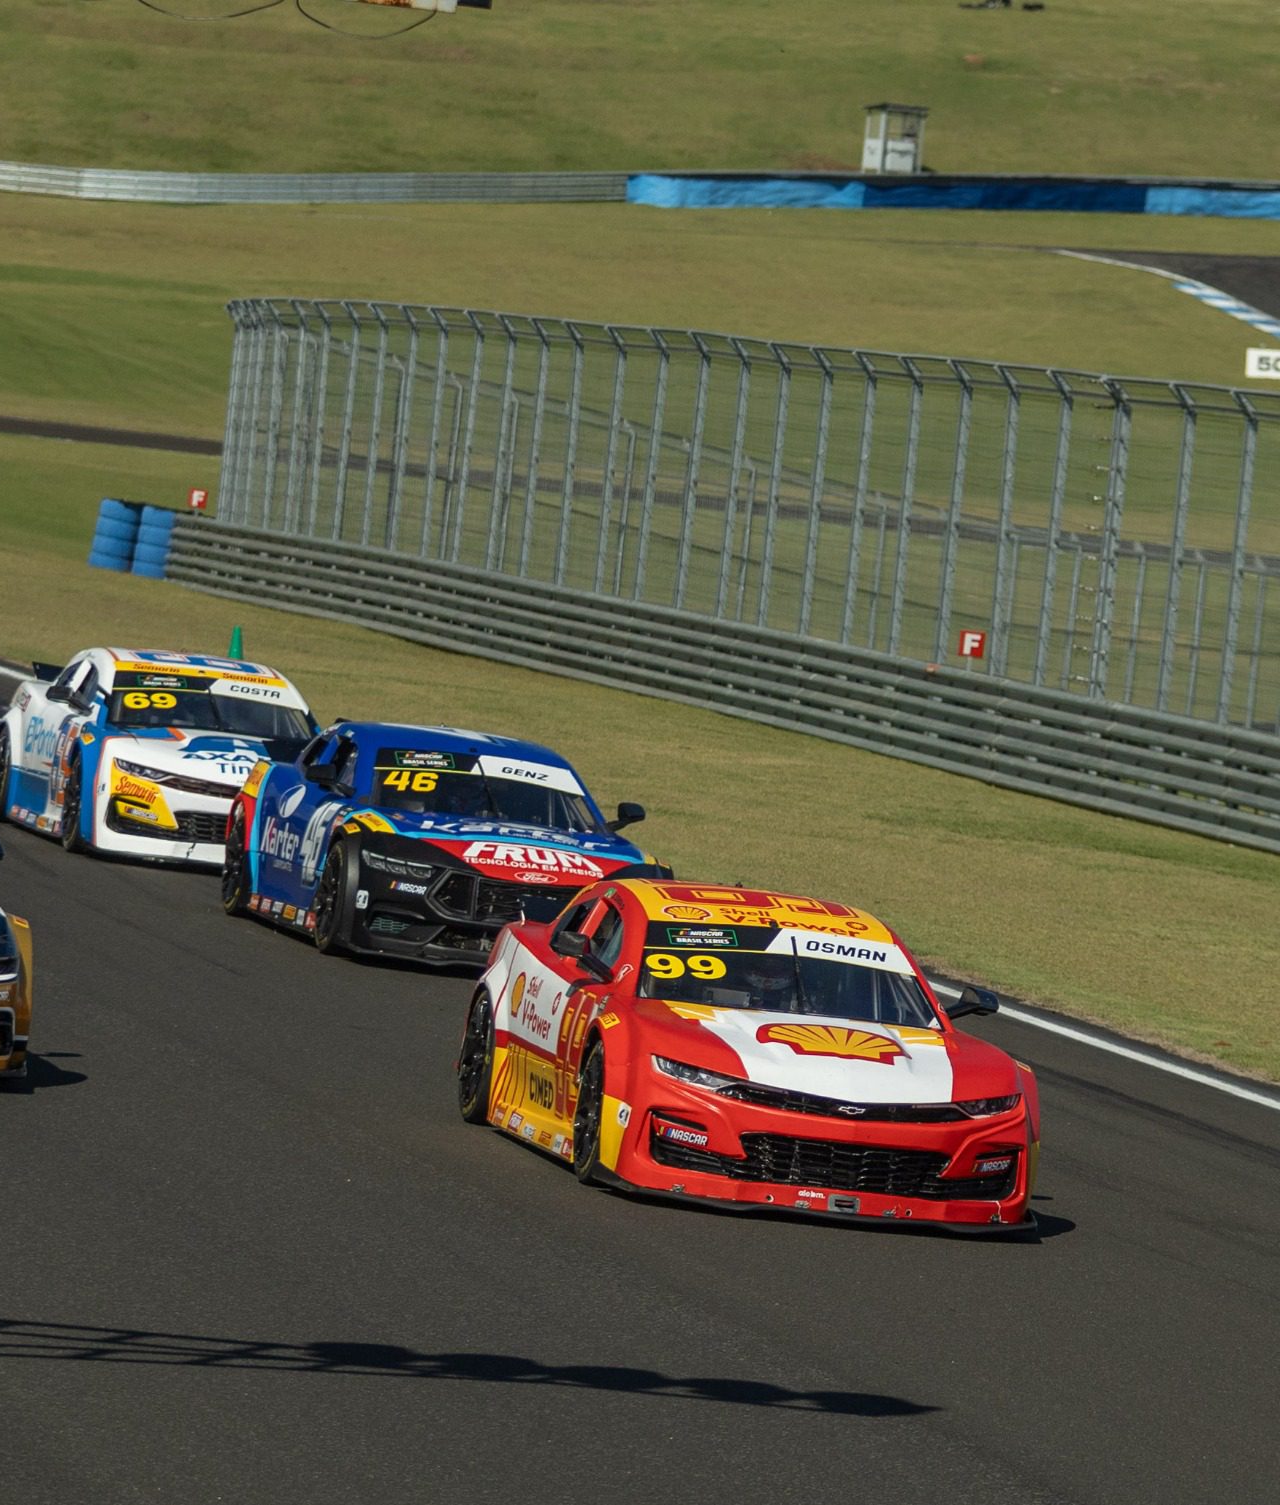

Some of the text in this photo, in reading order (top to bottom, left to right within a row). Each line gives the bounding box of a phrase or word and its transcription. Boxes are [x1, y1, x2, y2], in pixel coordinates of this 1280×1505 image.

[191, 490, 206, 507] F
[962, 632, 982, 655] F
[133, 663, 181, 674] Semorin
[222, 672, 268, 685] Semorin
[230, 684, 281, 699] COSTA
[123, 692, 178, 710] 69
[383, 770, 440, 792] 46
[501, 766, 550, 782] GENZ
[115, 775, 158, 804] Semorin
[260, 815, 300, 862] Karter
[463, 841, 604, 873] FRUM
[463, 856, 605, 879] TECNOLOGIA EM FREIOS
[397, 882, 428, 896] NASCAR
[719, 907, 771, 917] Shell
[689, 929, 724, 937] NASCAR
[723, 914, 861, 938] V-Power
[676, 937, 730, 945] BRASIL SERIES
[805, 940, 888, 963] OSMAN
[644, 953, 728, 980] 99
[522, 998, 552, 1041] V-Power
[529, 1071, 554, 1110] CIMED
[669, 1128, 708, 1146] NASCAR
[980, 1158, 1011, 1172] NASCAR
